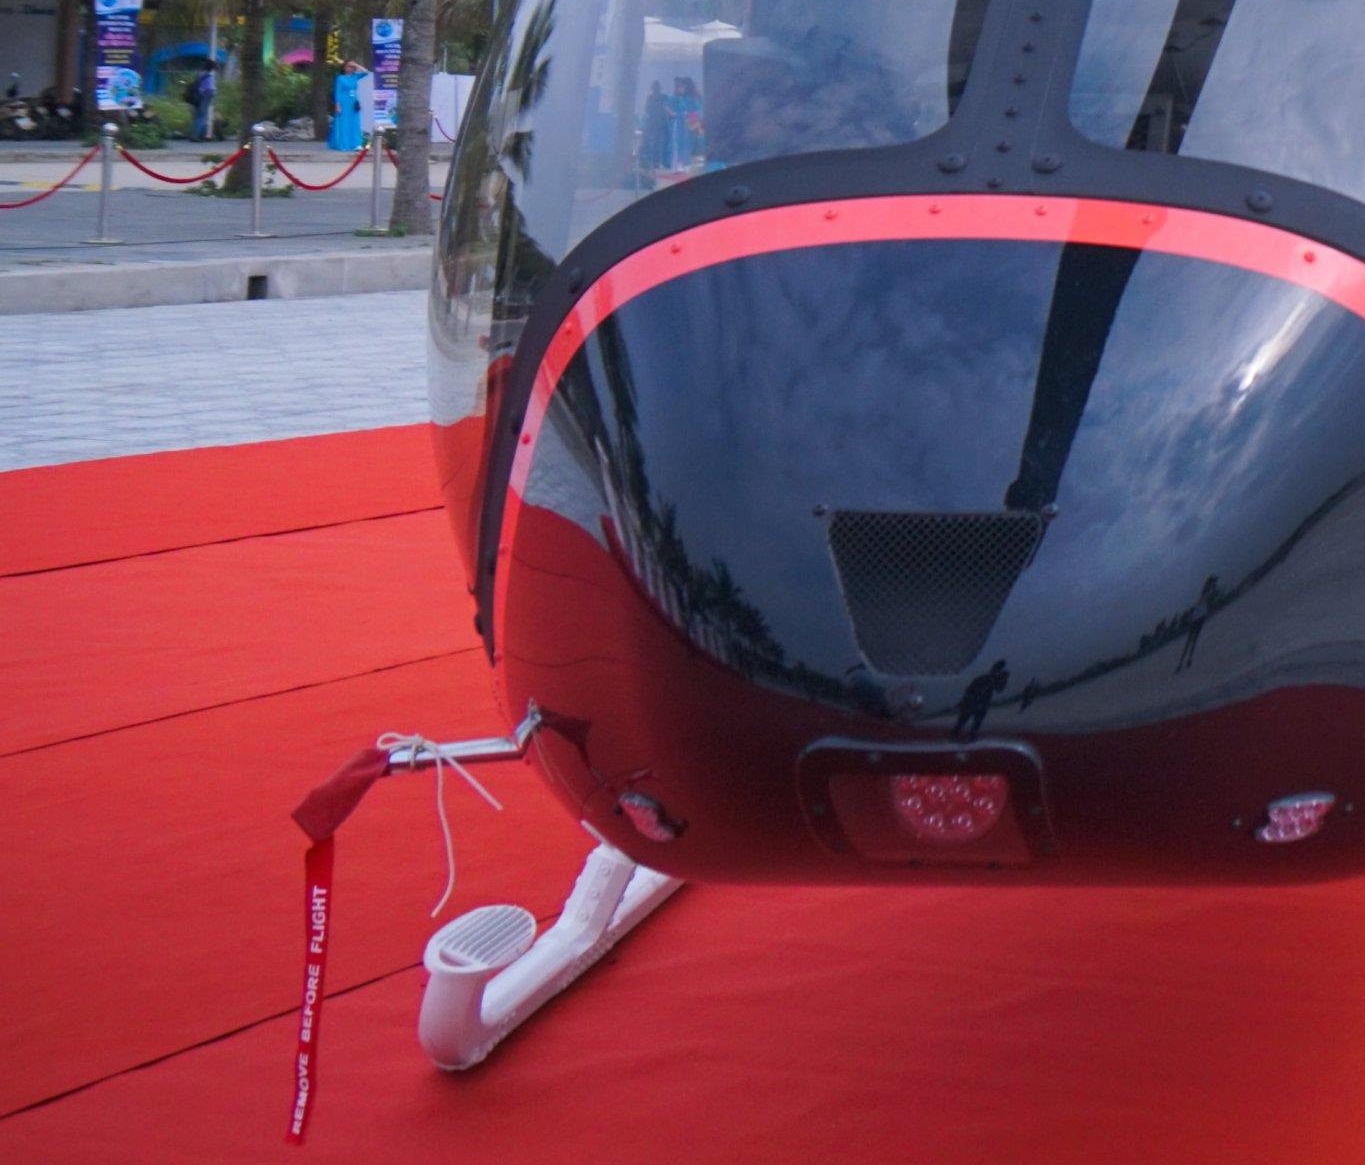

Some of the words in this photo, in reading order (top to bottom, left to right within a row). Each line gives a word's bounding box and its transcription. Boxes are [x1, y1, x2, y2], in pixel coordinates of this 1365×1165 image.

[310, 884, 328, 955] FLIGHT
[301, 963, 321, 1043] BEFORE
[292, 1052, 310, 1135] REMOVE
